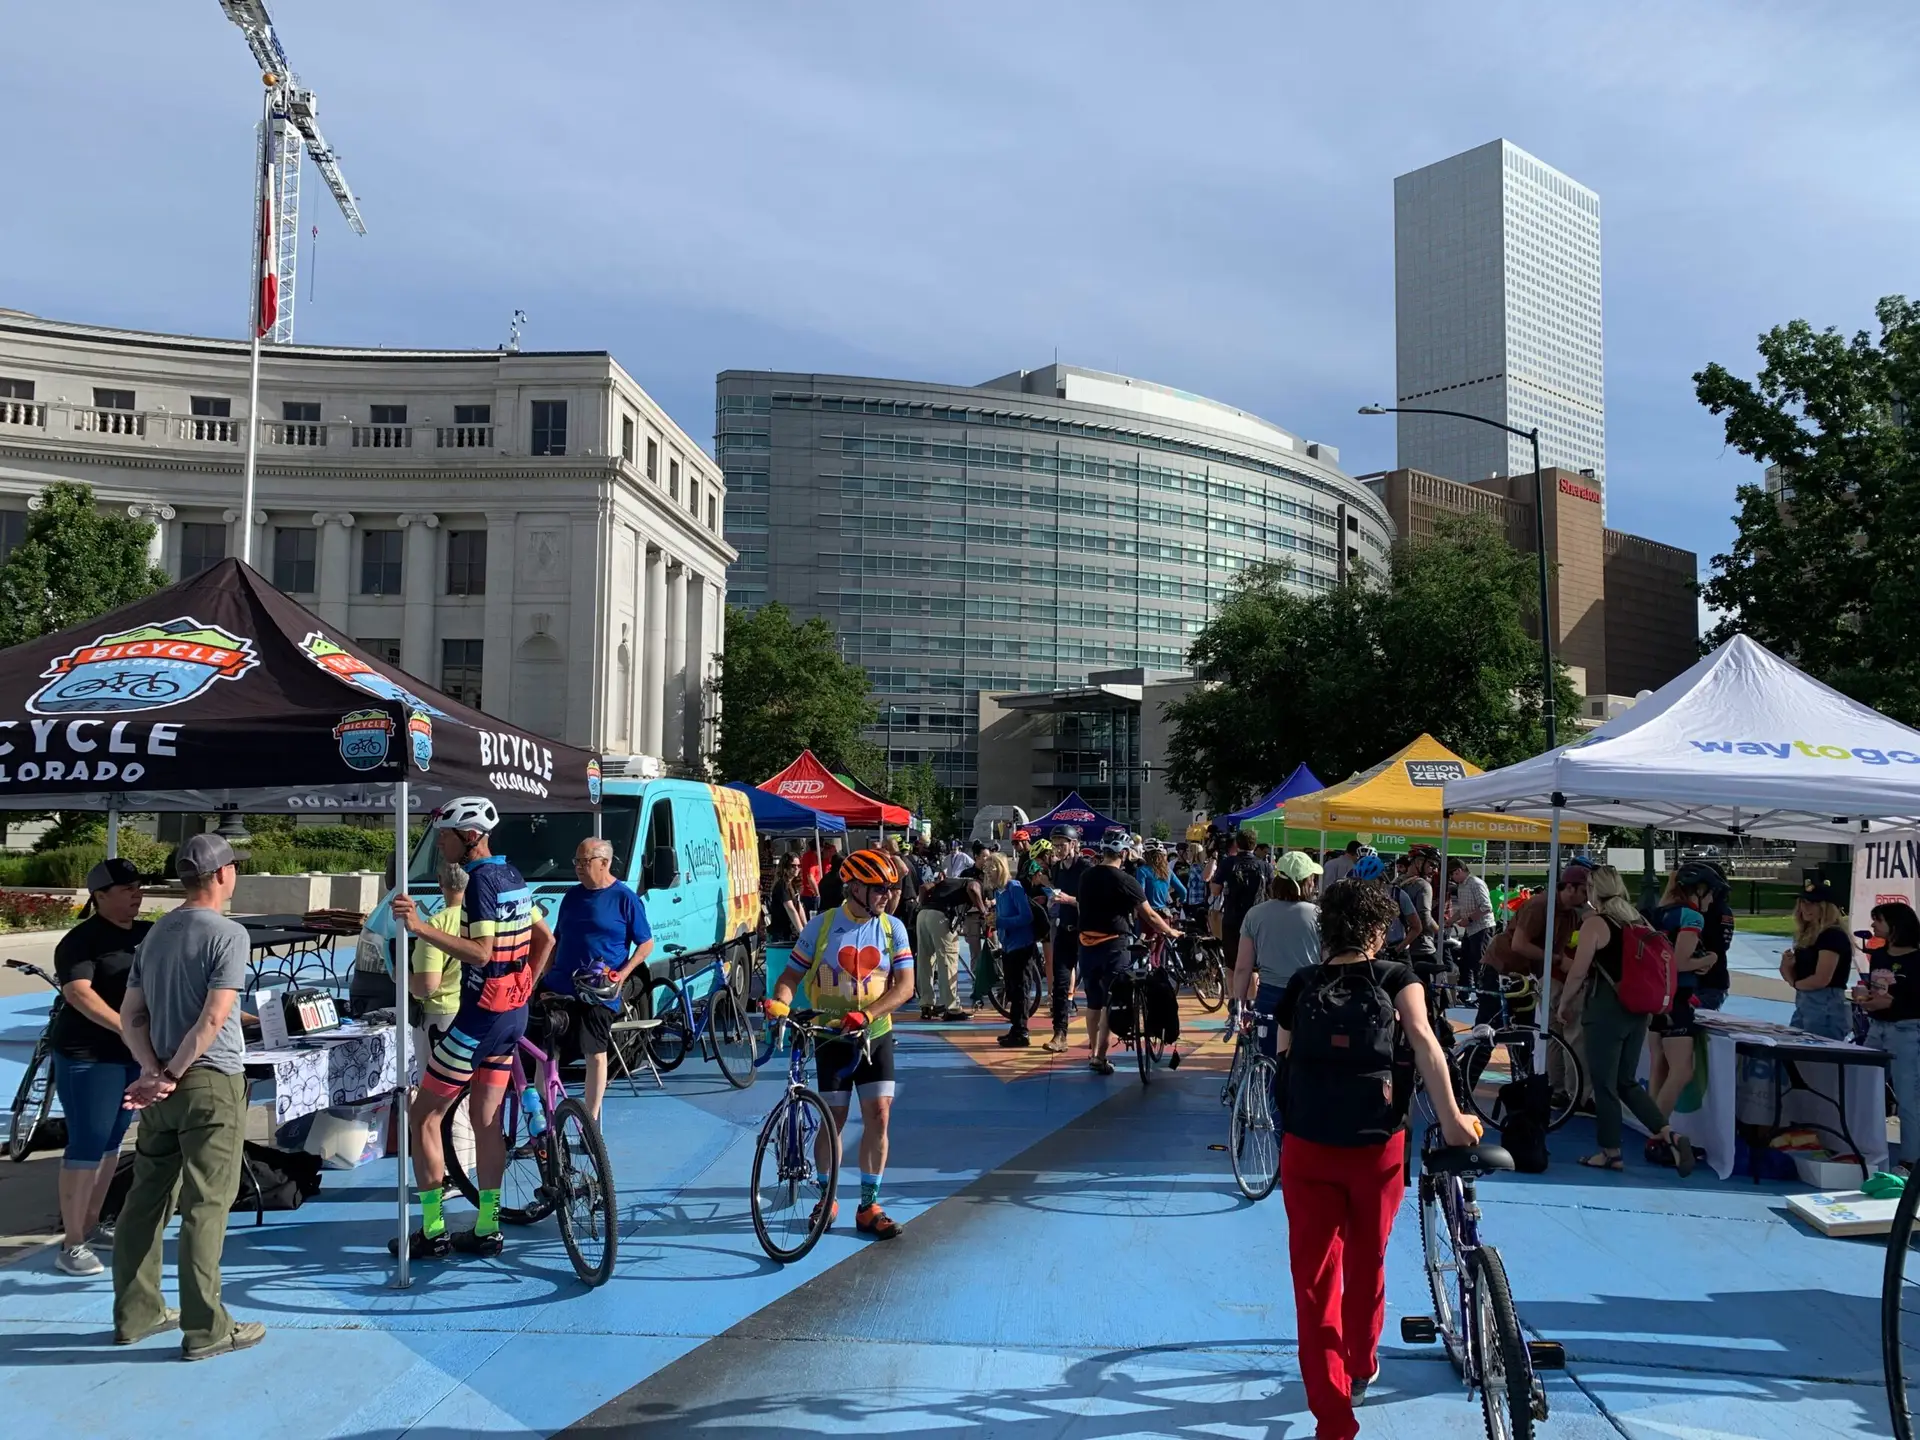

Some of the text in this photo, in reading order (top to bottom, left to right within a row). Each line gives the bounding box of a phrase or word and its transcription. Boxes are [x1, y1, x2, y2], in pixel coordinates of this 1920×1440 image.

[1559, 478, 1600, 503] Sheraton
[89, 642, 230, 663] BICYCLE
[95, 659, 198, 671] COLORADO
[344, 720, 386, 730] BICYCLE
[478, 731, 553, 781] BICYCLE
[1411, 764, 1460, 772] VISION
[1412, 772, 1462, 780] ZERO
[489, 771, 548, 799] COLORADO
[776, 780, 824, 794] RTD
[1372, 816, 1391, 826] NO
[1395, 818, 1431, 828] MORE
[1434, 820, 1486, 831] TAFFIC
[1489, 822, 1539, 834] DEATHS
[319, 1002, 336, 1024] 15
